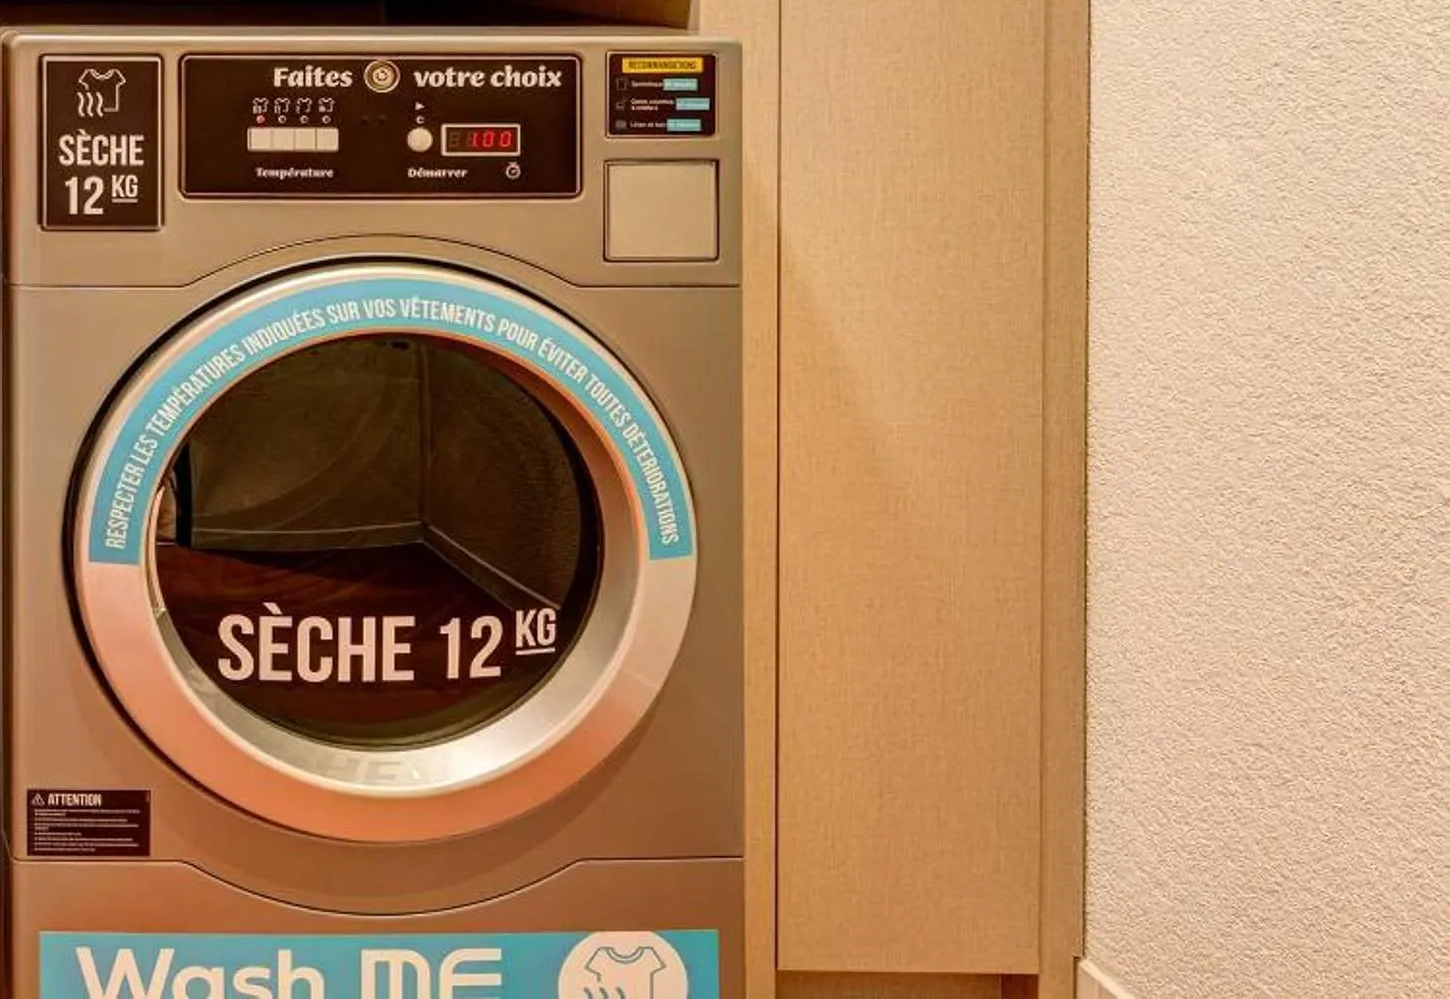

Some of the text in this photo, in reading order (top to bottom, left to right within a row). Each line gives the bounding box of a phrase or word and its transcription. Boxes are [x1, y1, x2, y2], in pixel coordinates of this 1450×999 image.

[273, 65, 562, 87] Faites votre choix
[58, 128, 145, 166] SÈCHE
[255, 166, 334, 180] Température
[407, 166, 468, 179] Démarrer
[65, 174, 139, 215] 12 KG
[106, 461, 144, 550] RESPECTER
[134, 433, 158, 467] LES
[242, 309, 327, 356] INDIQUÉES
[326, 301, 360, 324] SUR
[362, 298, 396, 319] VOS
[400, 294, 495, 333] VÊTEMENTS
[497, 317, 539, 351] POUR
[537, 337, 589, 385] ÉVITER
[584, 373, 631, 428] TOUTES
[218, 602, 556, 683] SÈCHE 12 KG
[48, 793, 102, 806] ATTENTION
